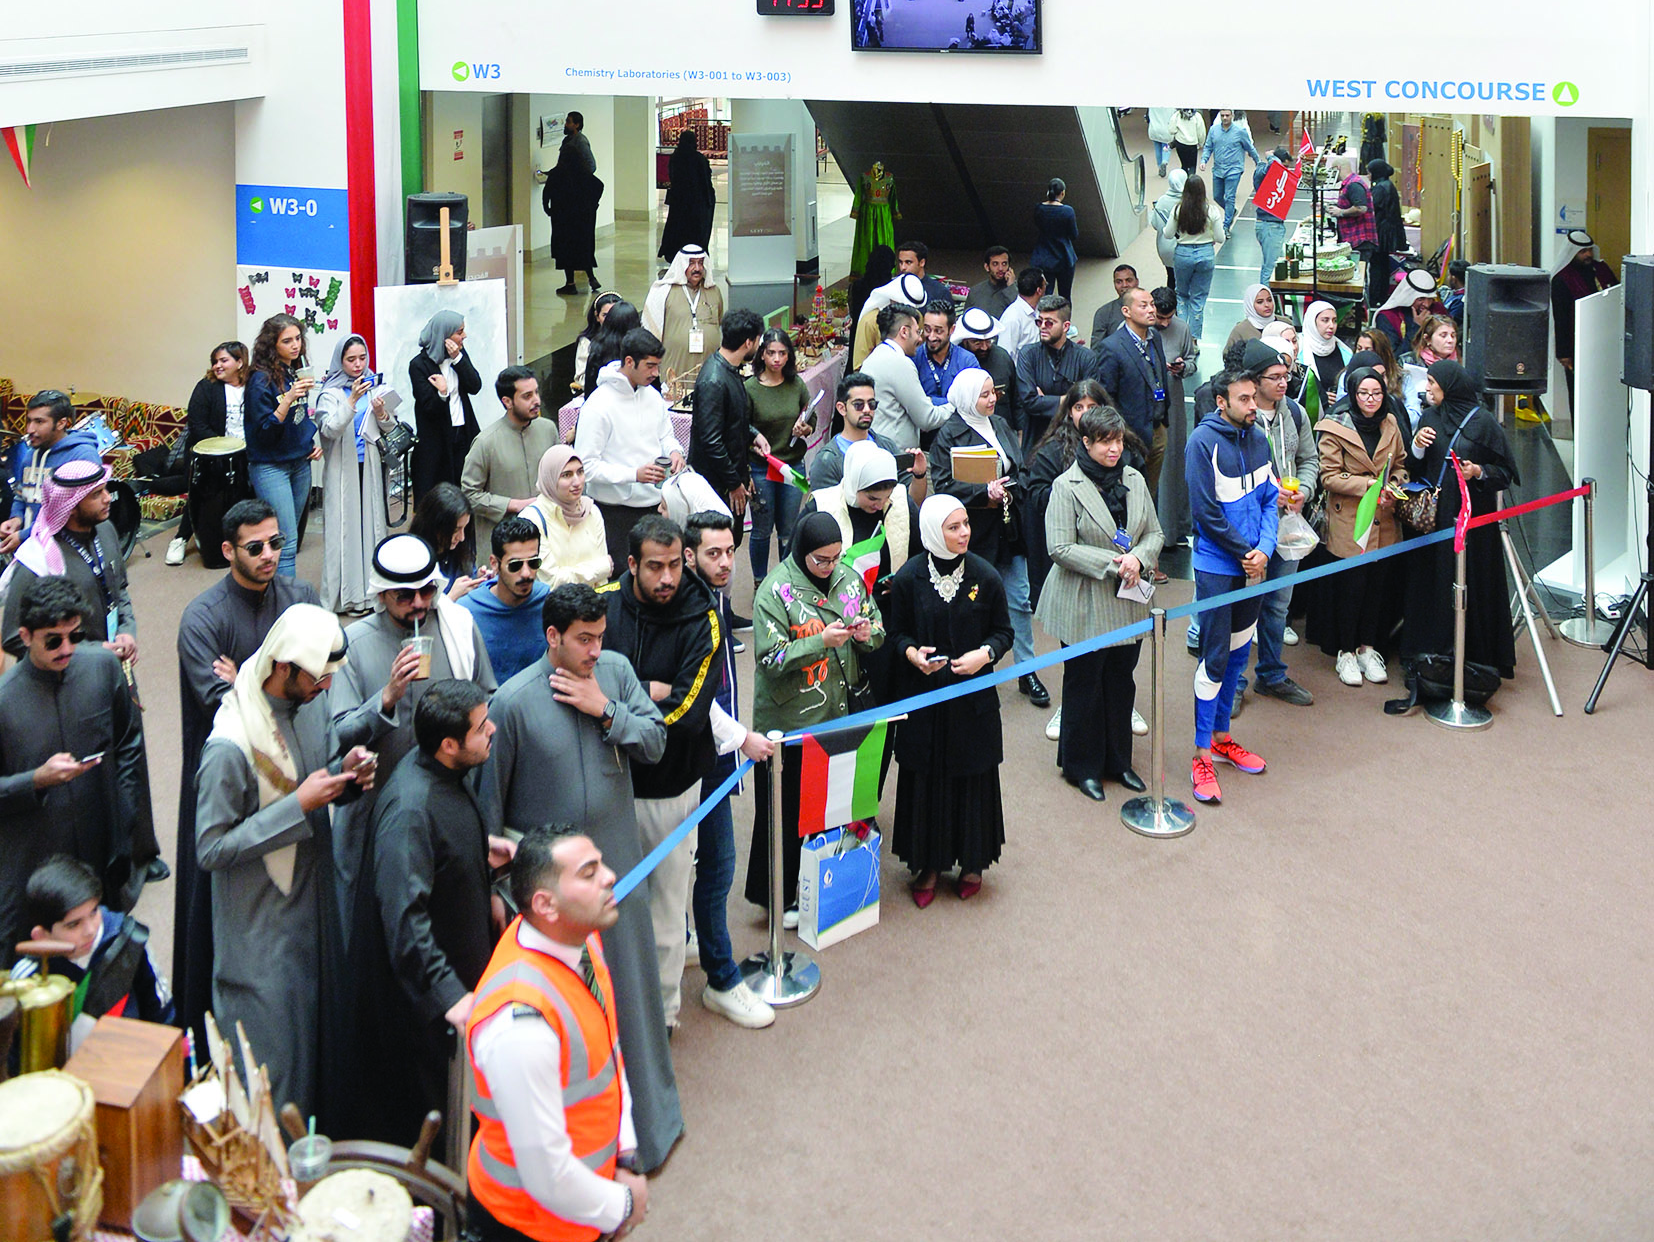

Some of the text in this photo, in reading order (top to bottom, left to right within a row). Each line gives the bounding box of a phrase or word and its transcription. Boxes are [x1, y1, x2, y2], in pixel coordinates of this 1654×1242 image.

[472, 63, 502, 79] W3
[565, 67, 791, 83] Chemistry Laboratories (W3-001 to W3-003)
[1306, 79, 1546, 102] WEST CONCOURSE
[268, 197, 318, 217] W3-0
[801, 876, 811, 912] GUST
